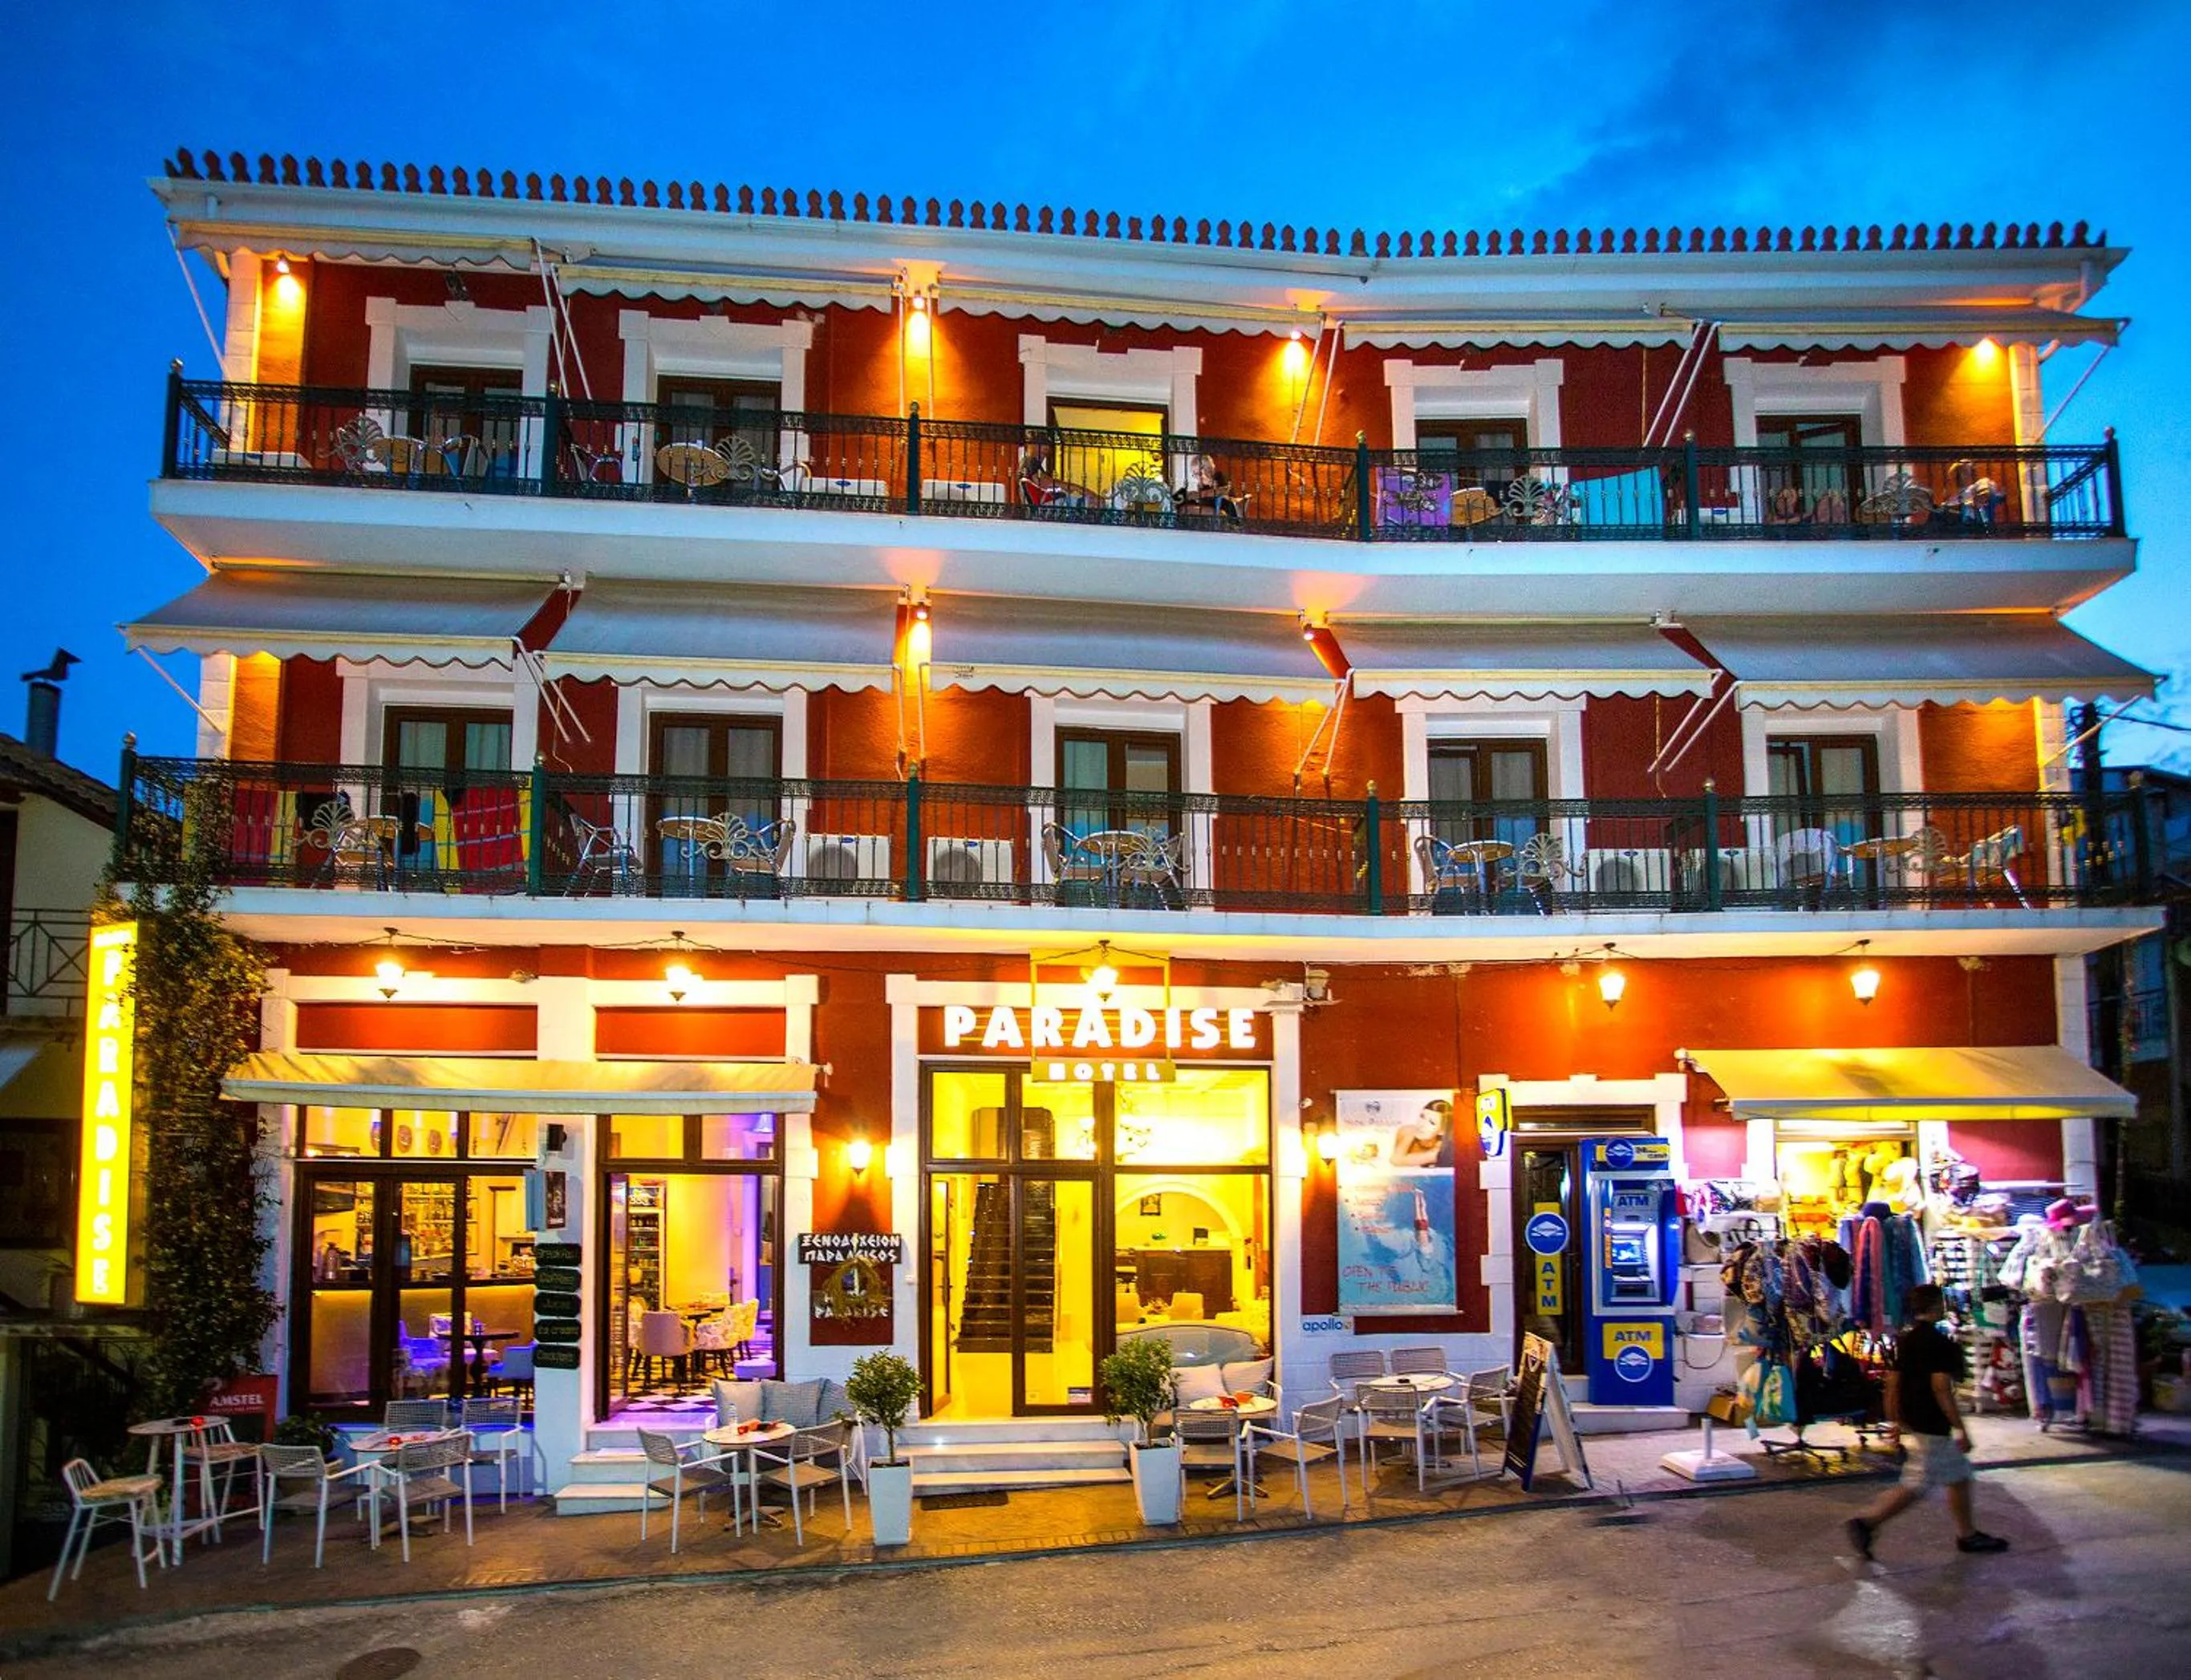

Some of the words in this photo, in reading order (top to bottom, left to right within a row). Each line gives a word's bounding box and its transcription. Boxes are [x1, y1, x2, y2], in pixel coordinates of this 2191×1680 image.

[943, 1005, 1256, 1049] PARADISE
[1048, 1062, 1160, 1081] HOTEL
[92, 949, 123, 1295] PARADISE
[1617, 1195, 1649, 1206] ATM
[1541, 1261, 1557, 1307] ATM
[1302, 1317, 1343, 1333] apollo
[1613, 1330, 1651, 1341] ATM
[209, 1394, 265, 1407] AMSTEL
